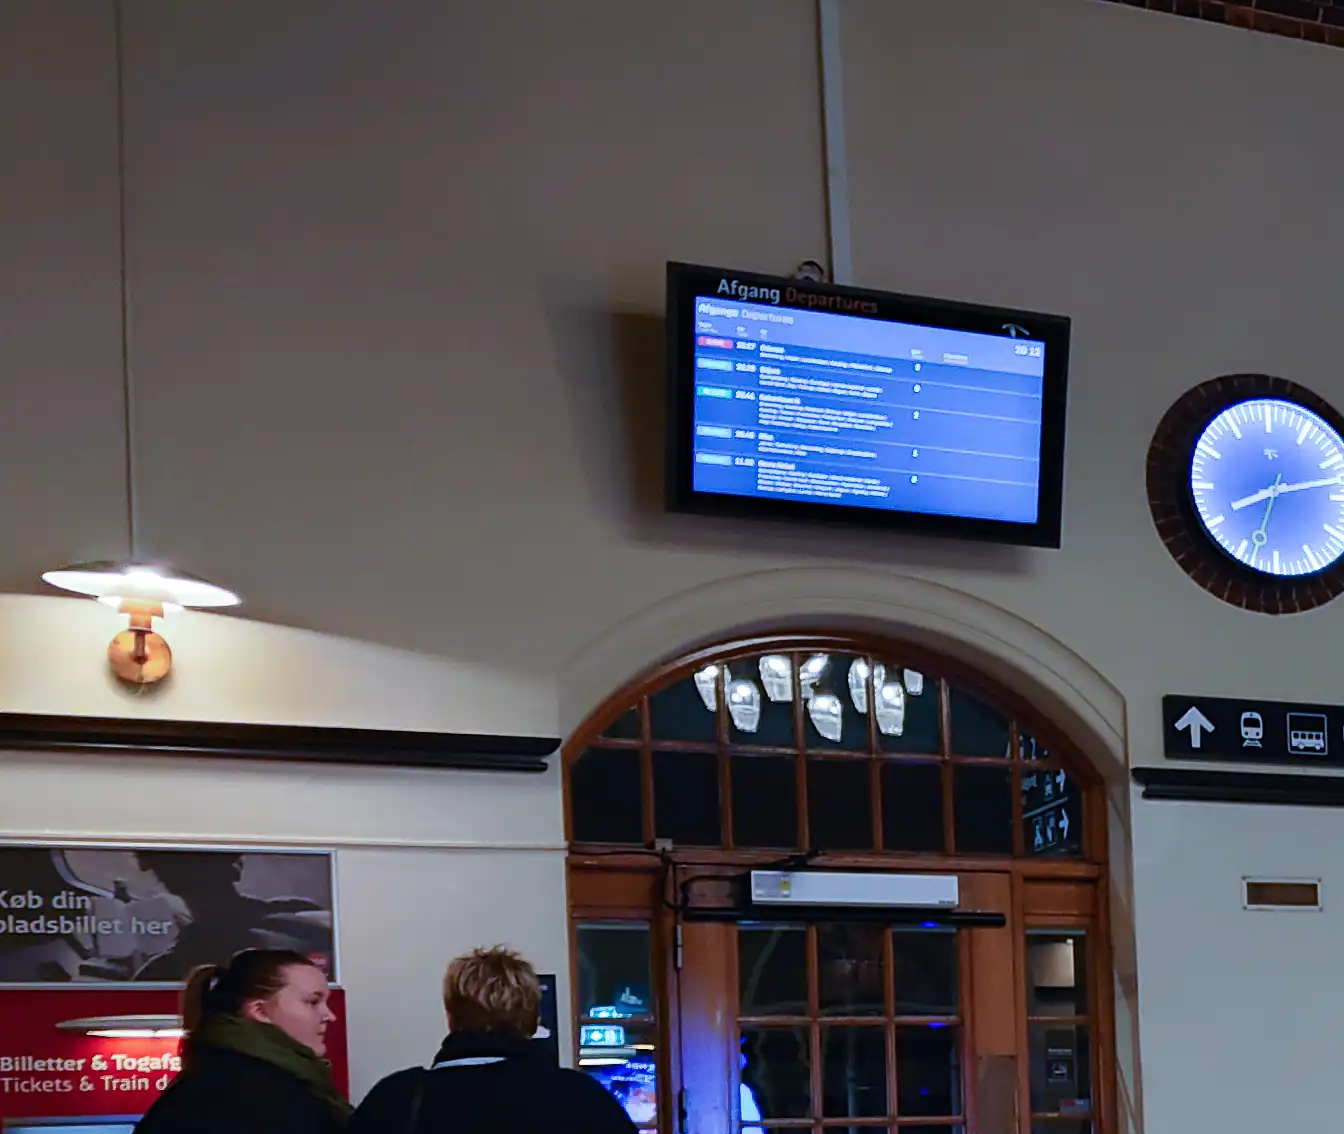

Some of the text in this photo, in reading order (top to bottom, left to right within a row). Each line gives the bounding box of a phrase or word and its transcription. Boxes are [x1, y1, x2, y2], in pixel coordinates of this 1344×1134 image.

[717, 279, 878, 314] Afgang Departures
[52, 890, 91, 909] din
[131, 915, 173, 935] her
[0, 1056, 86, 1072] Billetter
[91, 1054, 107, 1071] &
[2, 1076, 73, 1092] Tickets
[79, 1075, 94, 1092] &
[100, 1074, 149, 1091] Train
